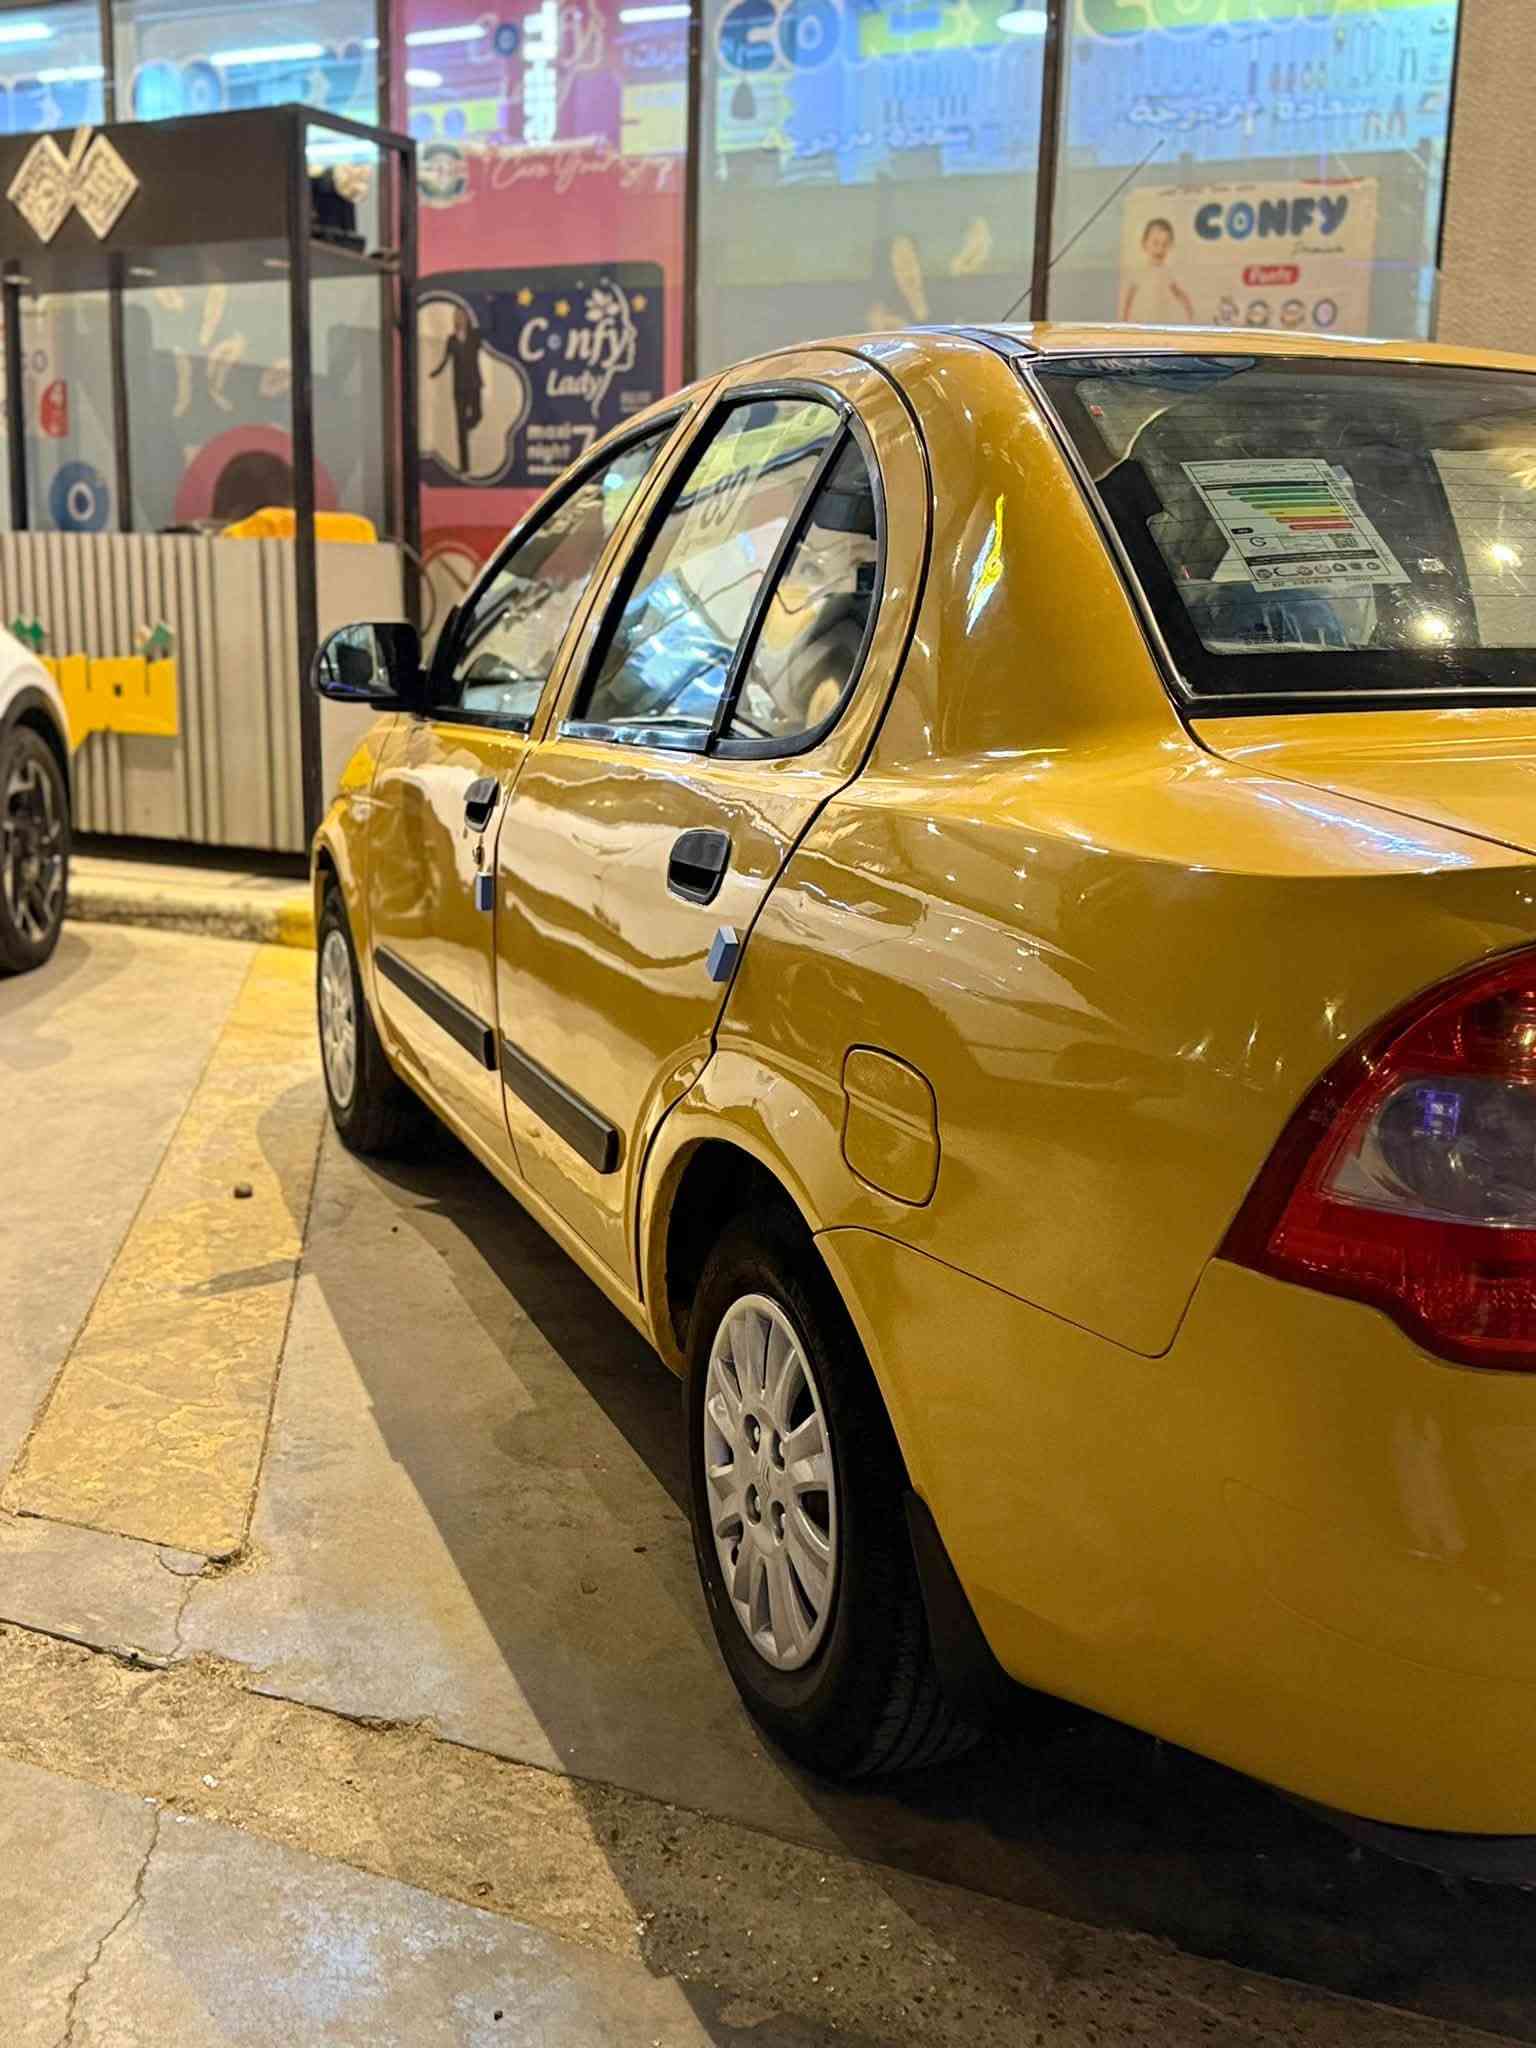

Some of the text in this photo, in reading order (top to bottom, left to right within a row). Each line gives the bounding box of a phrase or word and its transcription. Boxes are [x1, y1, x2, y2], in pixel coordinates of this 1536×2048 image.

[1193, 194, 1349, 240] CONFY
[518, 316, 630, 369] Confy
[546, 368, 606, 402] Lady
